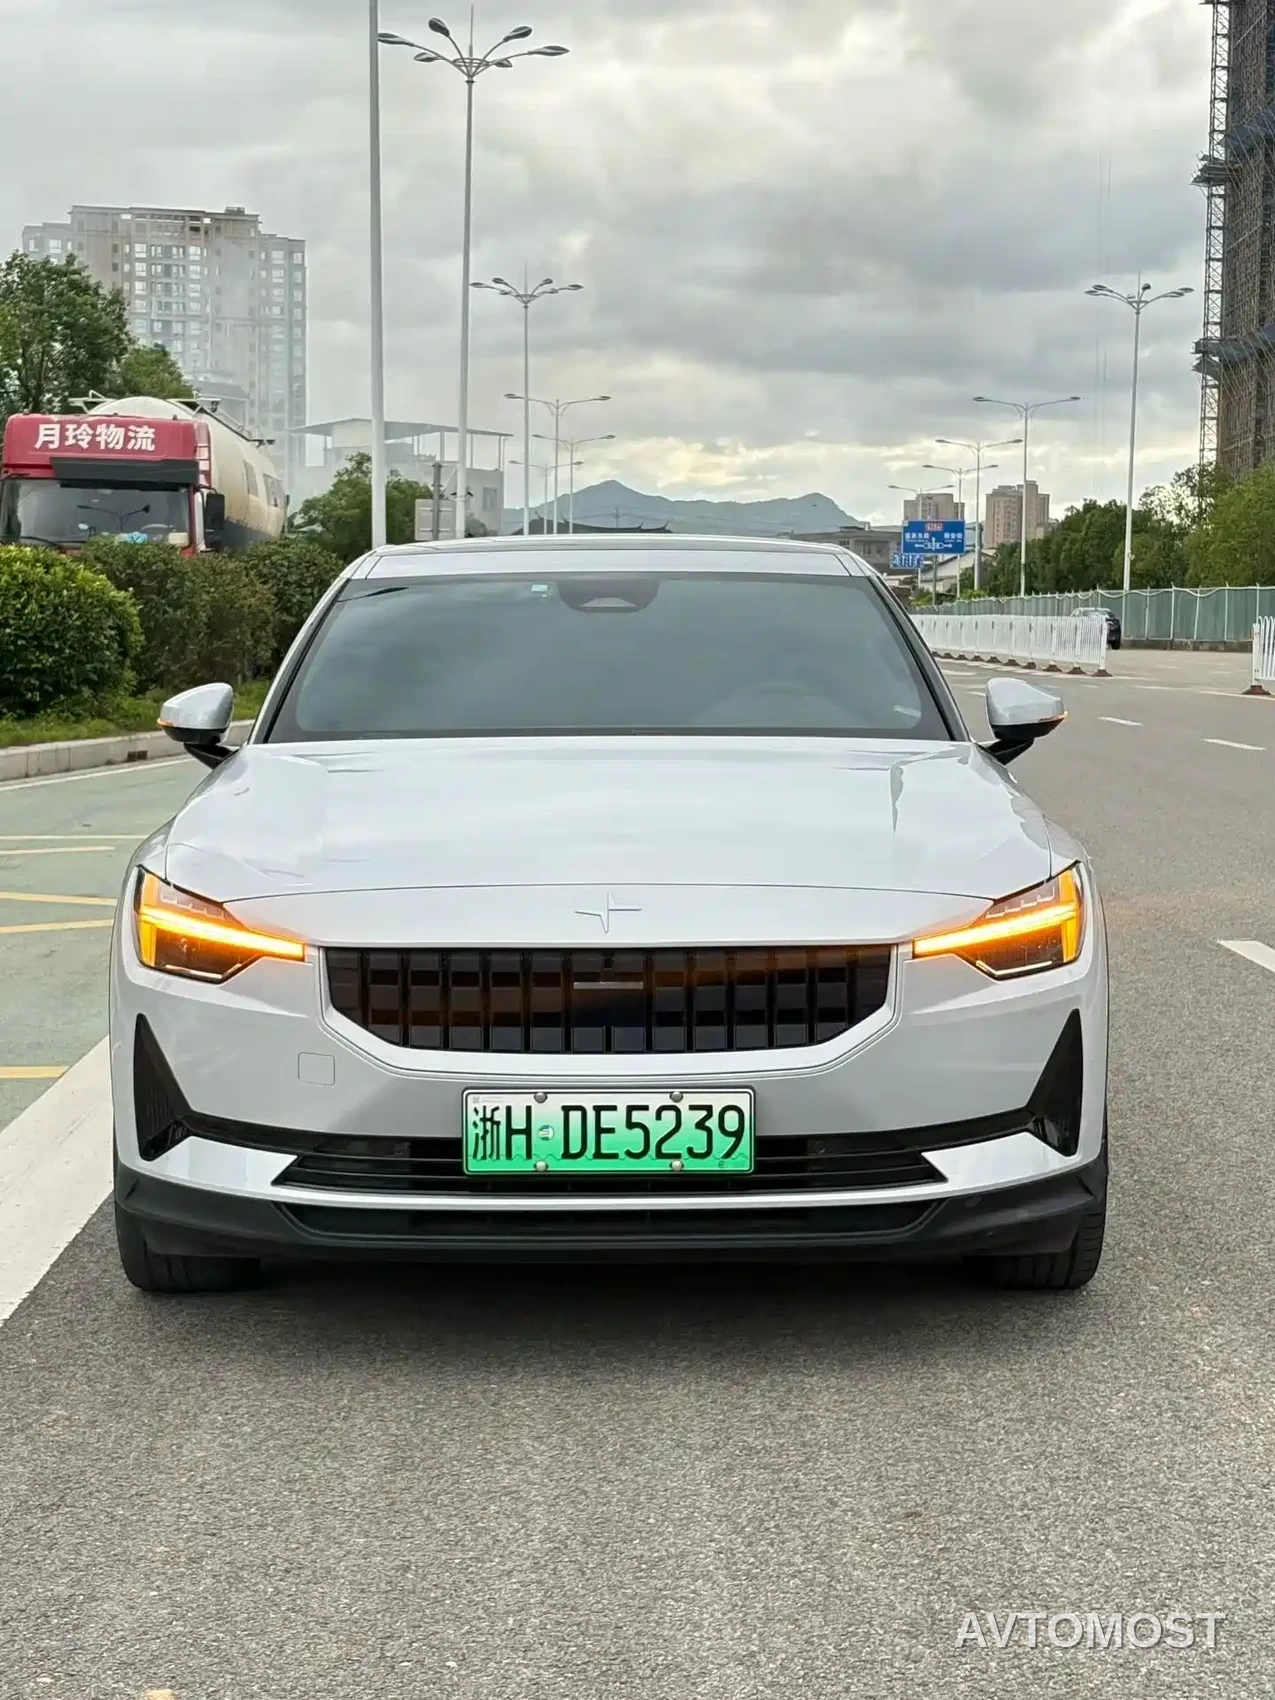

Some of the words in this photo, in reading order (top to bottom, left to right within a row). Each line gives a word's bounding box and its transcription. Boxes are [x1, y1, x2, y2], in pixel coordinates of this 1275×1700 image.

[34, 423, 156, 451] 月玲物流
[472, 1104, 533, 1160] 浙H
[561, 1104, 746, 1160] DE5239
